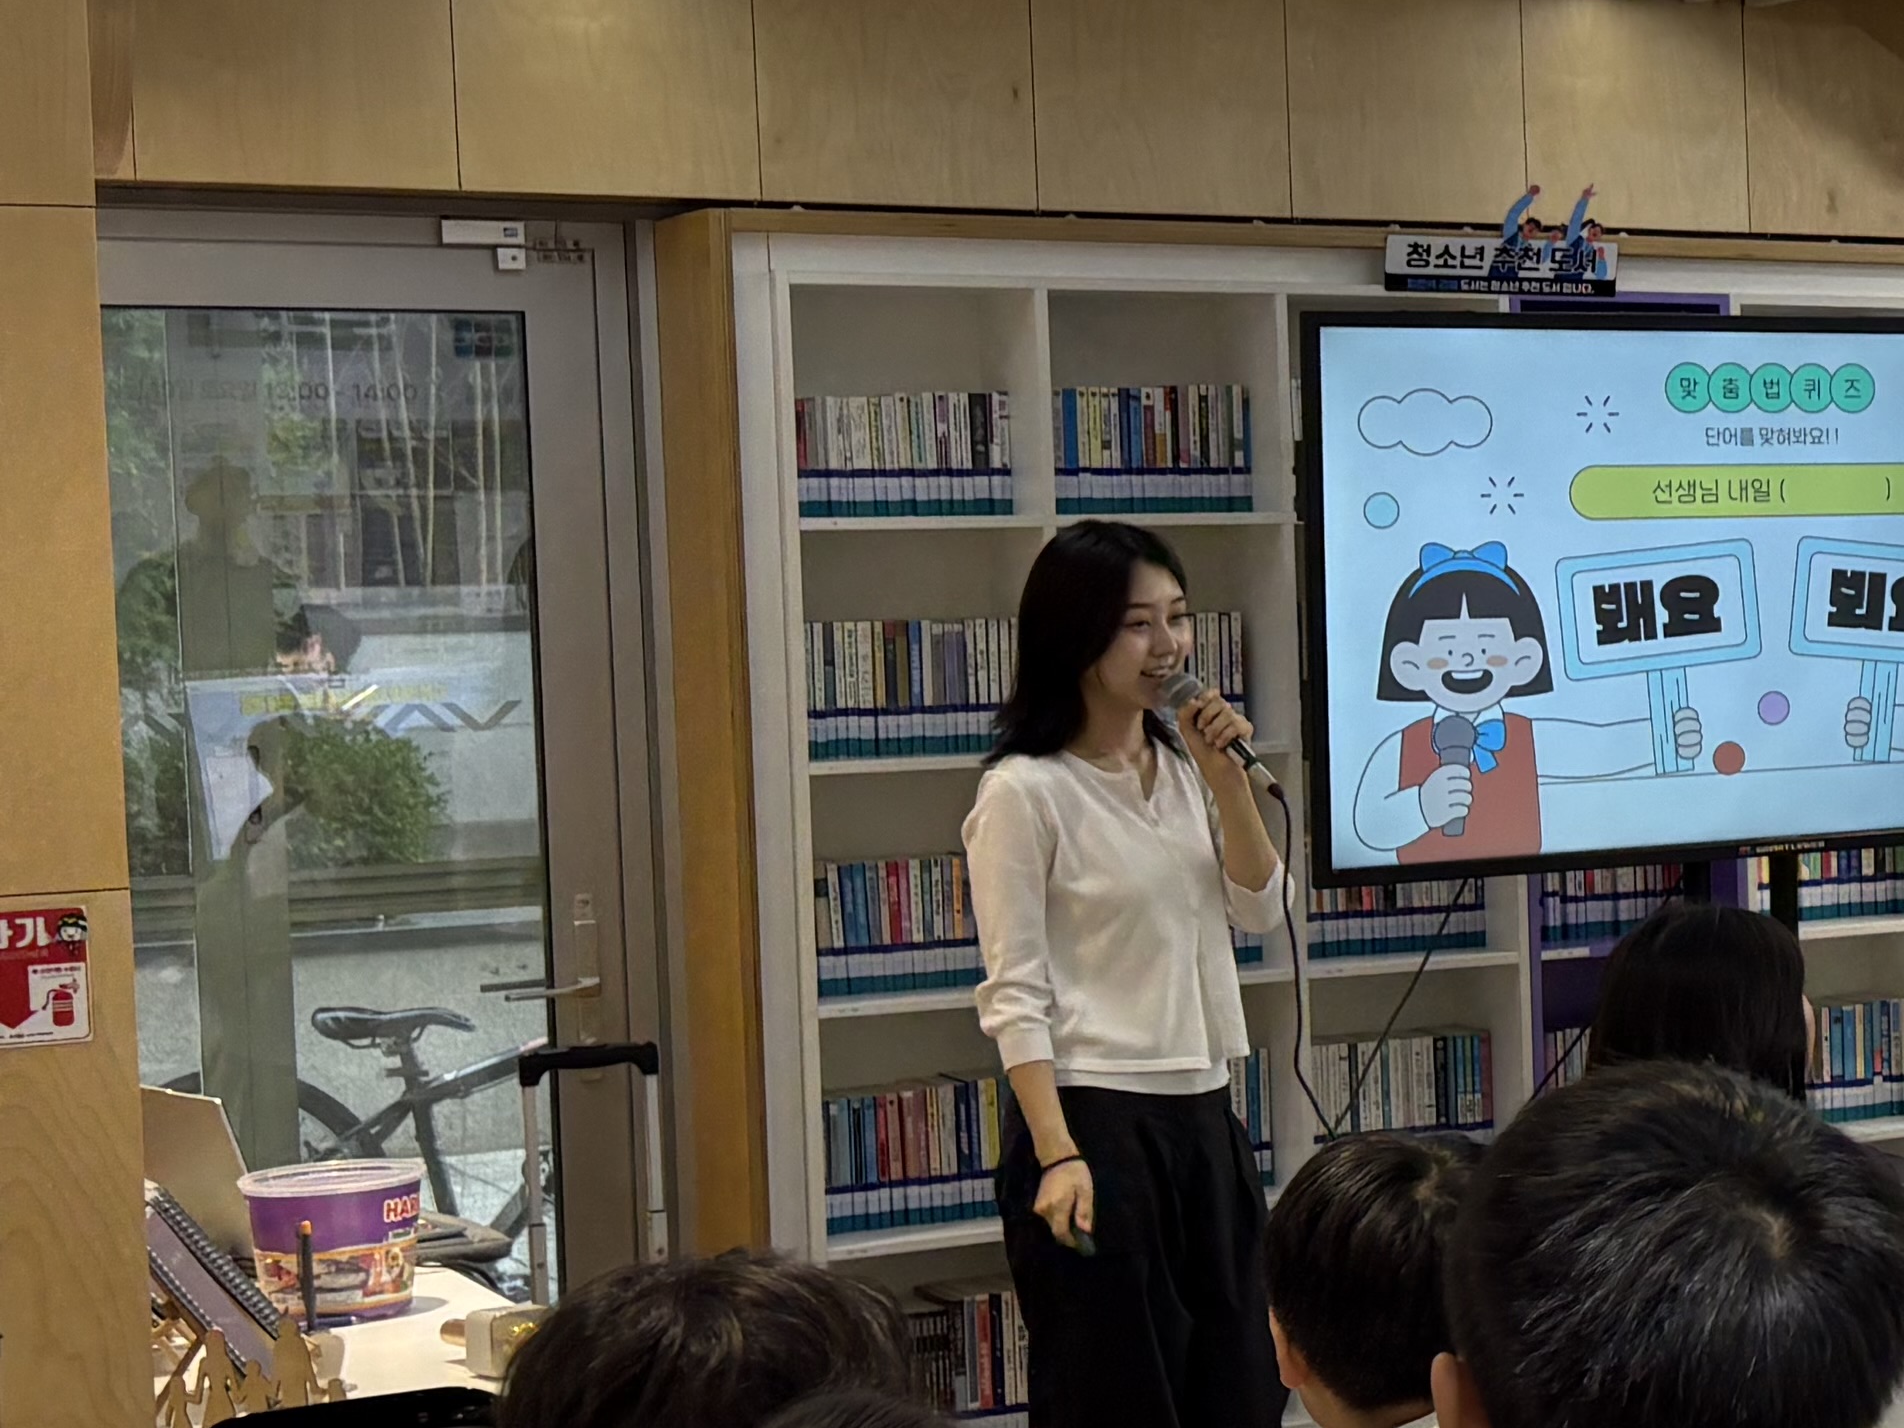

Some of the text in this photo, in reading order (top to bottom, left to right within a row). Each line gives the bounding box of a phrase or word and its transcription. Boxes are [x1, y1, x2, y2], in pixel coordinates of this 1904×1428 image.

[1405, 241, 1598, 274] 청소년 추천 도서
[1705, 427, 1754, 448] 단어를
[1652, 477, 1720, 505] 선생님
[1727, 476, 1772, 505] 내일
